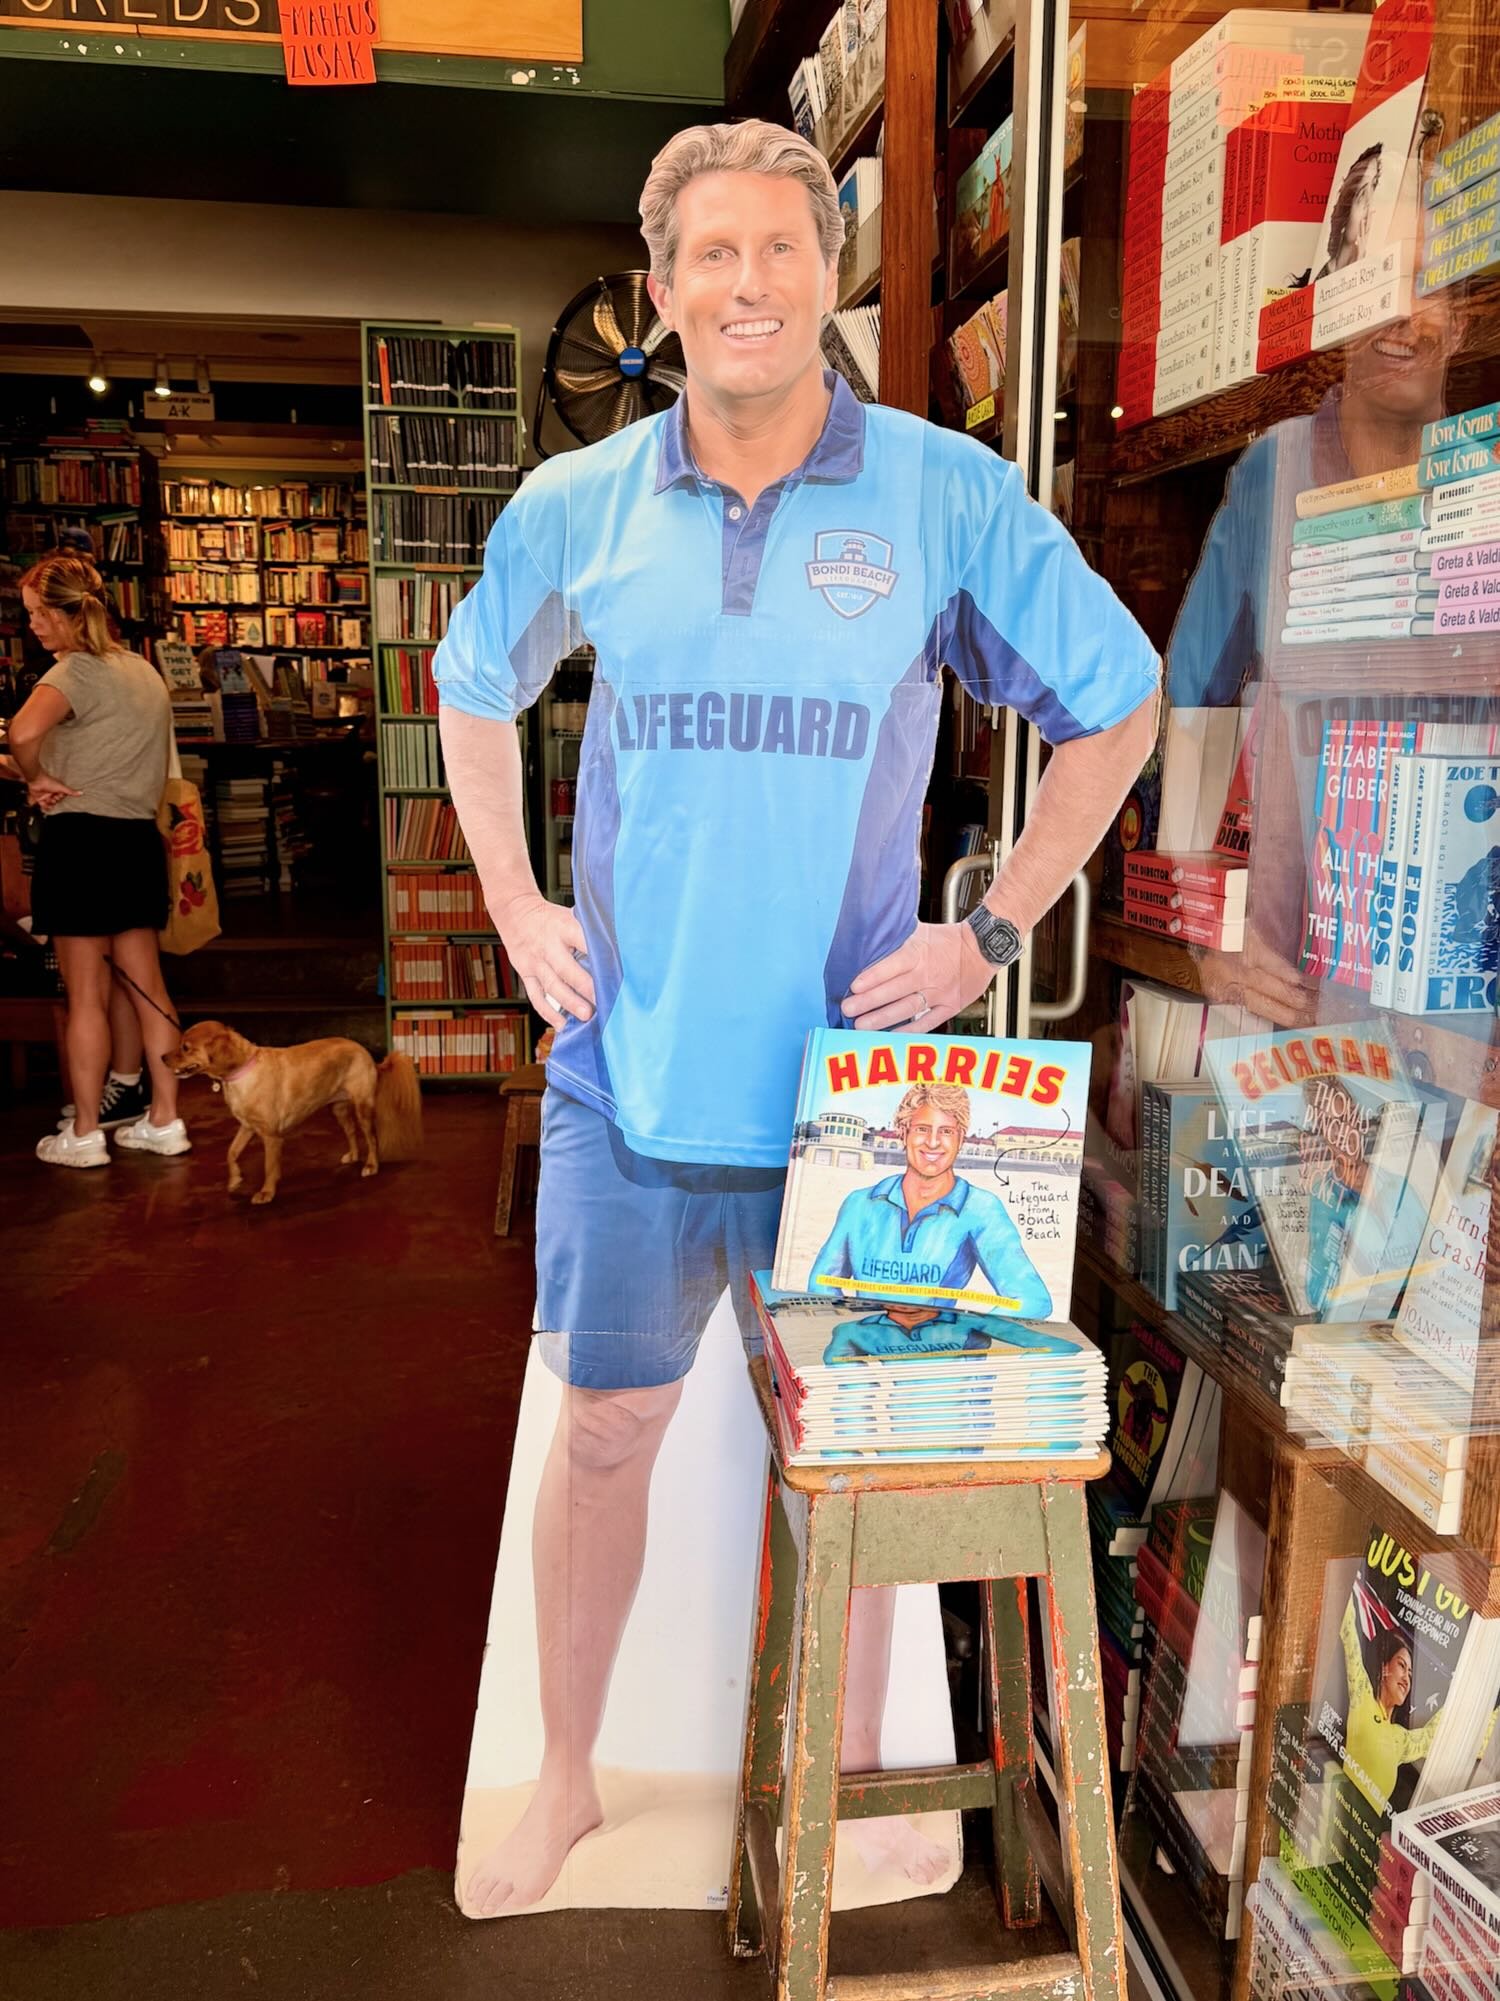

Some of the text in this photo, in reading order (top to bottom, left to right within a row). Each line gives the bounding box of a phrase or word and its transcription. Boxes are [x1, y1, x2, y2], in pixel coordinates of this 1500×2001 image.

[286, 43, 367, 80] ZUSAK
[1299, 121, 1345, 141] Moth
[1293, 145, 1338, 164] Com
[1319, 264, 1377, 304] Arundhati Roy
[1316, 304, 1375, 339] Arundhati Roy
[1430, 412, 1494, 447] love forms
[1426, 448, 1489, 480] love forms
[811, 565, 892, 585] BONDI BEACH
[1438, 555, 1463, 570] Greta
[1466, 552, 1473, 567] &
[1445, 584, 1469, 599] Greta
[1472, 581, 1478, 596] &
[1440, 612, 1466, 627] Greta
[1468, 610, 1475, 625] &
[164, 656, 192, 664] THEY
[171, 668, 191, 676] GET
[615, 691, 871, 761] LIFEGUARD
[1322, 744, 1414, 770] ELIZABE
[1327, 774, 1388, 803] GILBER
[1447, 766, 1485, 781] ZOE
[1223, 811, 1240, 827] THE
[1217, 827, 1251, 852] DIRE
[1127, 863, 1139, 875] THE
[1140, 865, 1169, 881] DIRECTOR
[1321, 847, 1384, 879] ALL TH
[1127, 886, 1138, 899] THE
[1139, 889, 1169, 906] DIRECTOR
[1317, 880, 1357, 910] WAY
[1127, 909, 1138, 921] THE
[1139, 912, 1167, 931] DIRECTOR
[1308, 913, 1338, 941] THE
[1374, 860, 1398, 967] EROS
[1398, 864, 1422, 973] EROS
[1321, 954, 1337, 966] Loss
[1338, 959, 1352, 970] and
[827, 1043, 1067, 1107] HARRIES
[1315, 1080, 1372, 1134] THOMAS
[1303, 1103, 1368, 1161] PYNCHON
[1160, 1138, 1168, 1181] DEATH
[1009, 1190, 1069, 1207] Lifeguard
[1031, 1181, 1050, 1191] The
[1018, 1209, 1060, 1226] Bondi
[1027, 1204, 1050, 1215] from
[1220, 1215, 1251, 1226] AND
[1026, 1227, 1061, 1240] Beach
[1178, 1244, 1268, 1272] GIAN
[1403, 1304, 1452, 1353] JOANNA
[1142, 1363, 1160, 1387] THE
[1115, 1425, 1152, 1467] MIDNIGHT
[1395, 1588, 1460, 1640] TURNING FEAR INTO
[1398, 1606, 1450, 1649] A SUPERPOWER
[1317, 1720, 1339, 1753] SAYA
[1336, 1788, 1350, 1812] What
[1352, 1810, 1362, 1823] We
[1362, 1822, 1375, 1841] Can
[1415, 1809, 1465, 1837] KITCHEN
[1333, 1817, 1350, 1838] What
[1349, 1836, 1360, 1851] We
[1360, 1849, 1373, 1868] Can
[1324, 1865, 1340, 1889] What
[1340, 1887, 1350, 1900] We
[1350, 1896, 1364, 1917] Can
[1398, 1831, 1430, 1871] KITCHEN
[1432, 1860, 1487, 1923] CONFIDENTIAL
[1264, 1877, 1293, 1924] dirtbag
[1323, 1884, 1356, 1930] SYDNEY
[1434, 1885, 1456, 1927] KITCHEN
[1253, 1903, 1285, 1950] dirtbag
[1322, 1904, 1355, 1952] SYDNEY
[1432, 1913, 1456, 1958] KITCHEN
